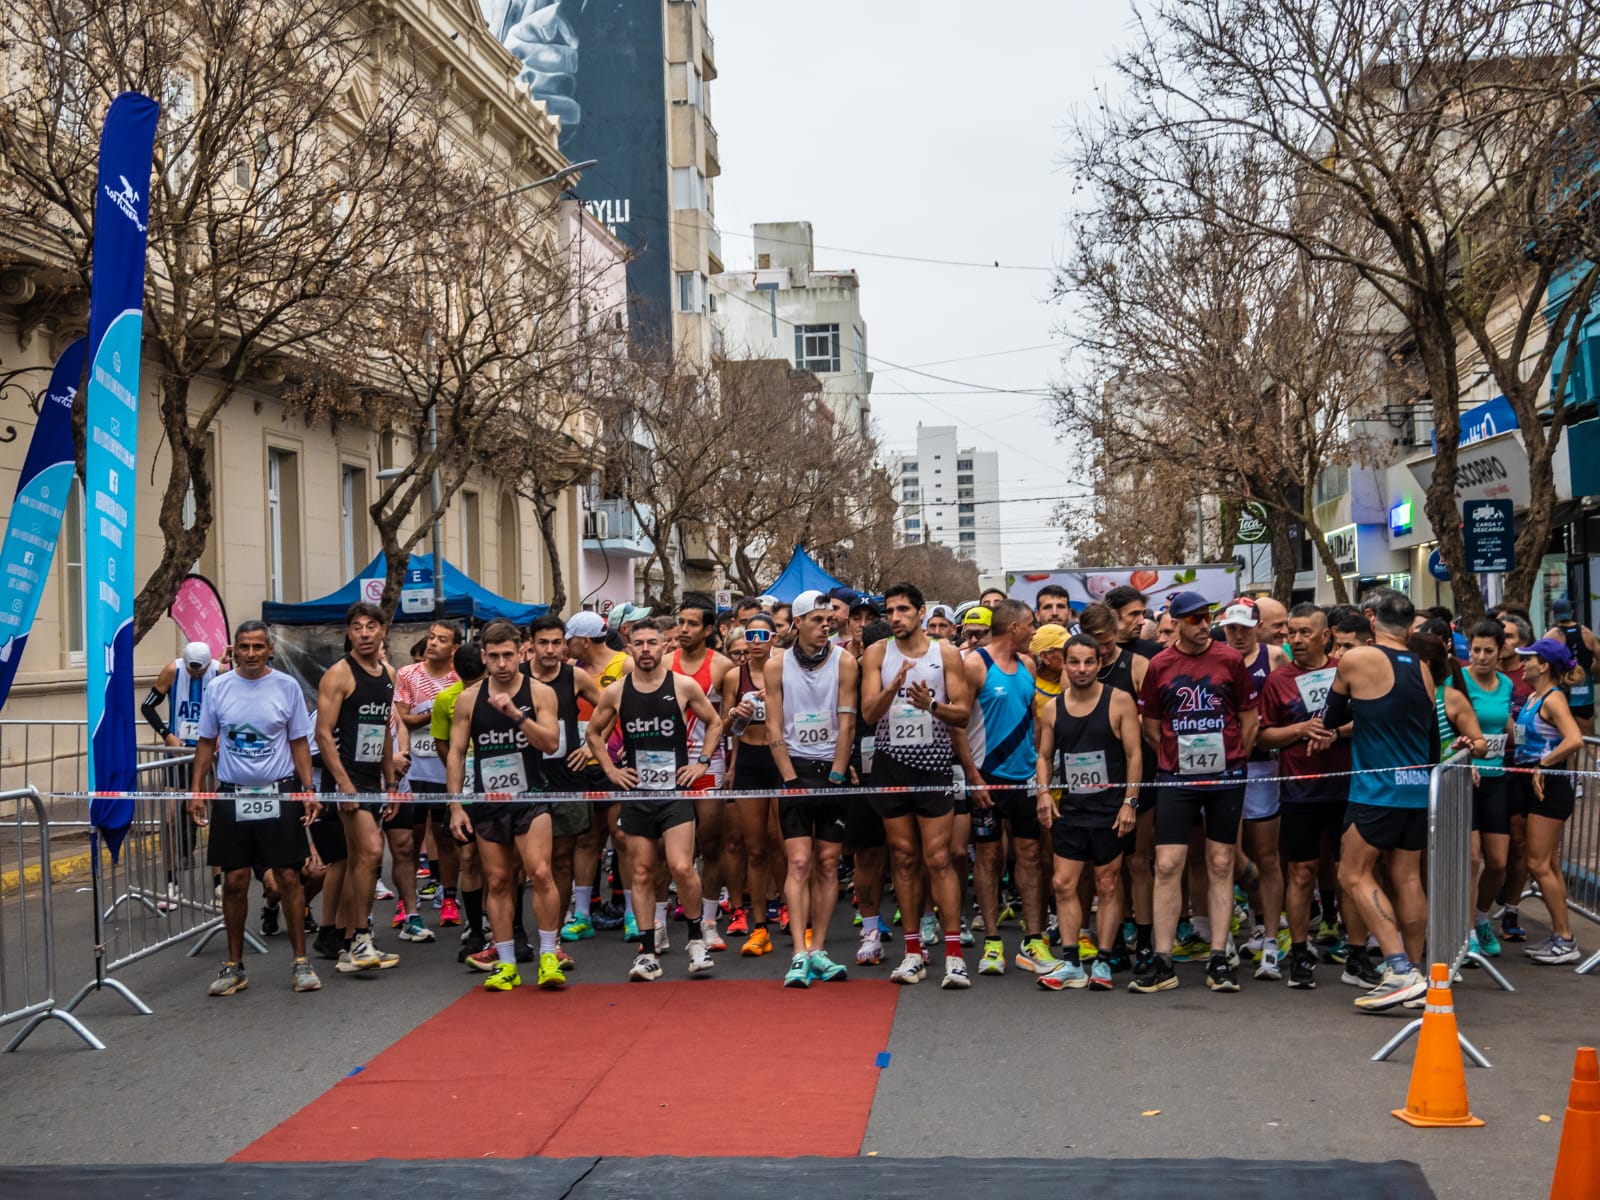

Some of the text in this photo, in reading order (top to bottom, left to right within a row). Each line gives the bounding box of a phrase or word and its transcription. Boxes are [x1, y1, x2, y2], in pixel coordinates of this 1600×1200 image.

[413, 571, 421, 582] E
[1309, 687, 1328, 703] 28
[178, 700, 201, 719] AR
[755, 706, 765, 719] 6
[799, 728, 829, 743] 203
[895, 724, 924, 738] 221
[1186, 753, 1218, 768] 147
[489, 772, 520, 790] 226
[641, 769, 669, 783] 323
[1071, 771, 1101, 787] 260
[242, 801, 273, 814] 295
